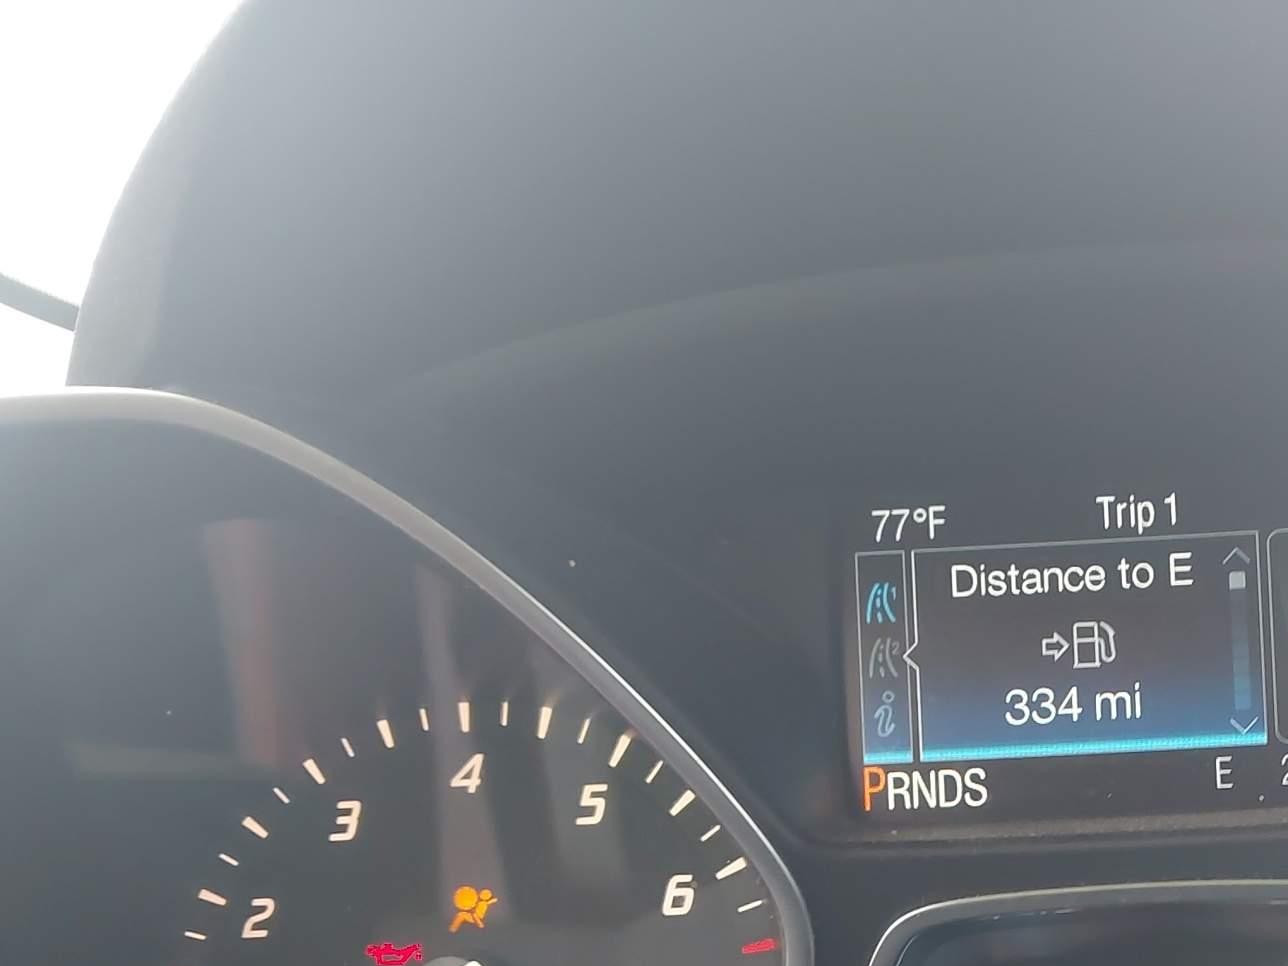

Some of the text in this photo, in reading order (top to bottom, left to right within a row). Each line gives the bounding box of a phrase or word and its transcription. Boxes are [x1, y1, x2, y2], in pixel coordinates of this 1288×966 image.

[871, 505, 947, 543] 77°F
[1095, 491, 1179, 534] Trip 1
[950, 552, 1195, 599] Distance to E
[1004, 682, 1143, 726] 334 mi
[450, 753, 486, 794] 4
[1214, 756, 1235, 789] E
[329, 800, 362, 842] 3
[576, 783, 609, 825] 5
[662, 874, 696, 916] 6
[241, 897, 275, 938] 2
